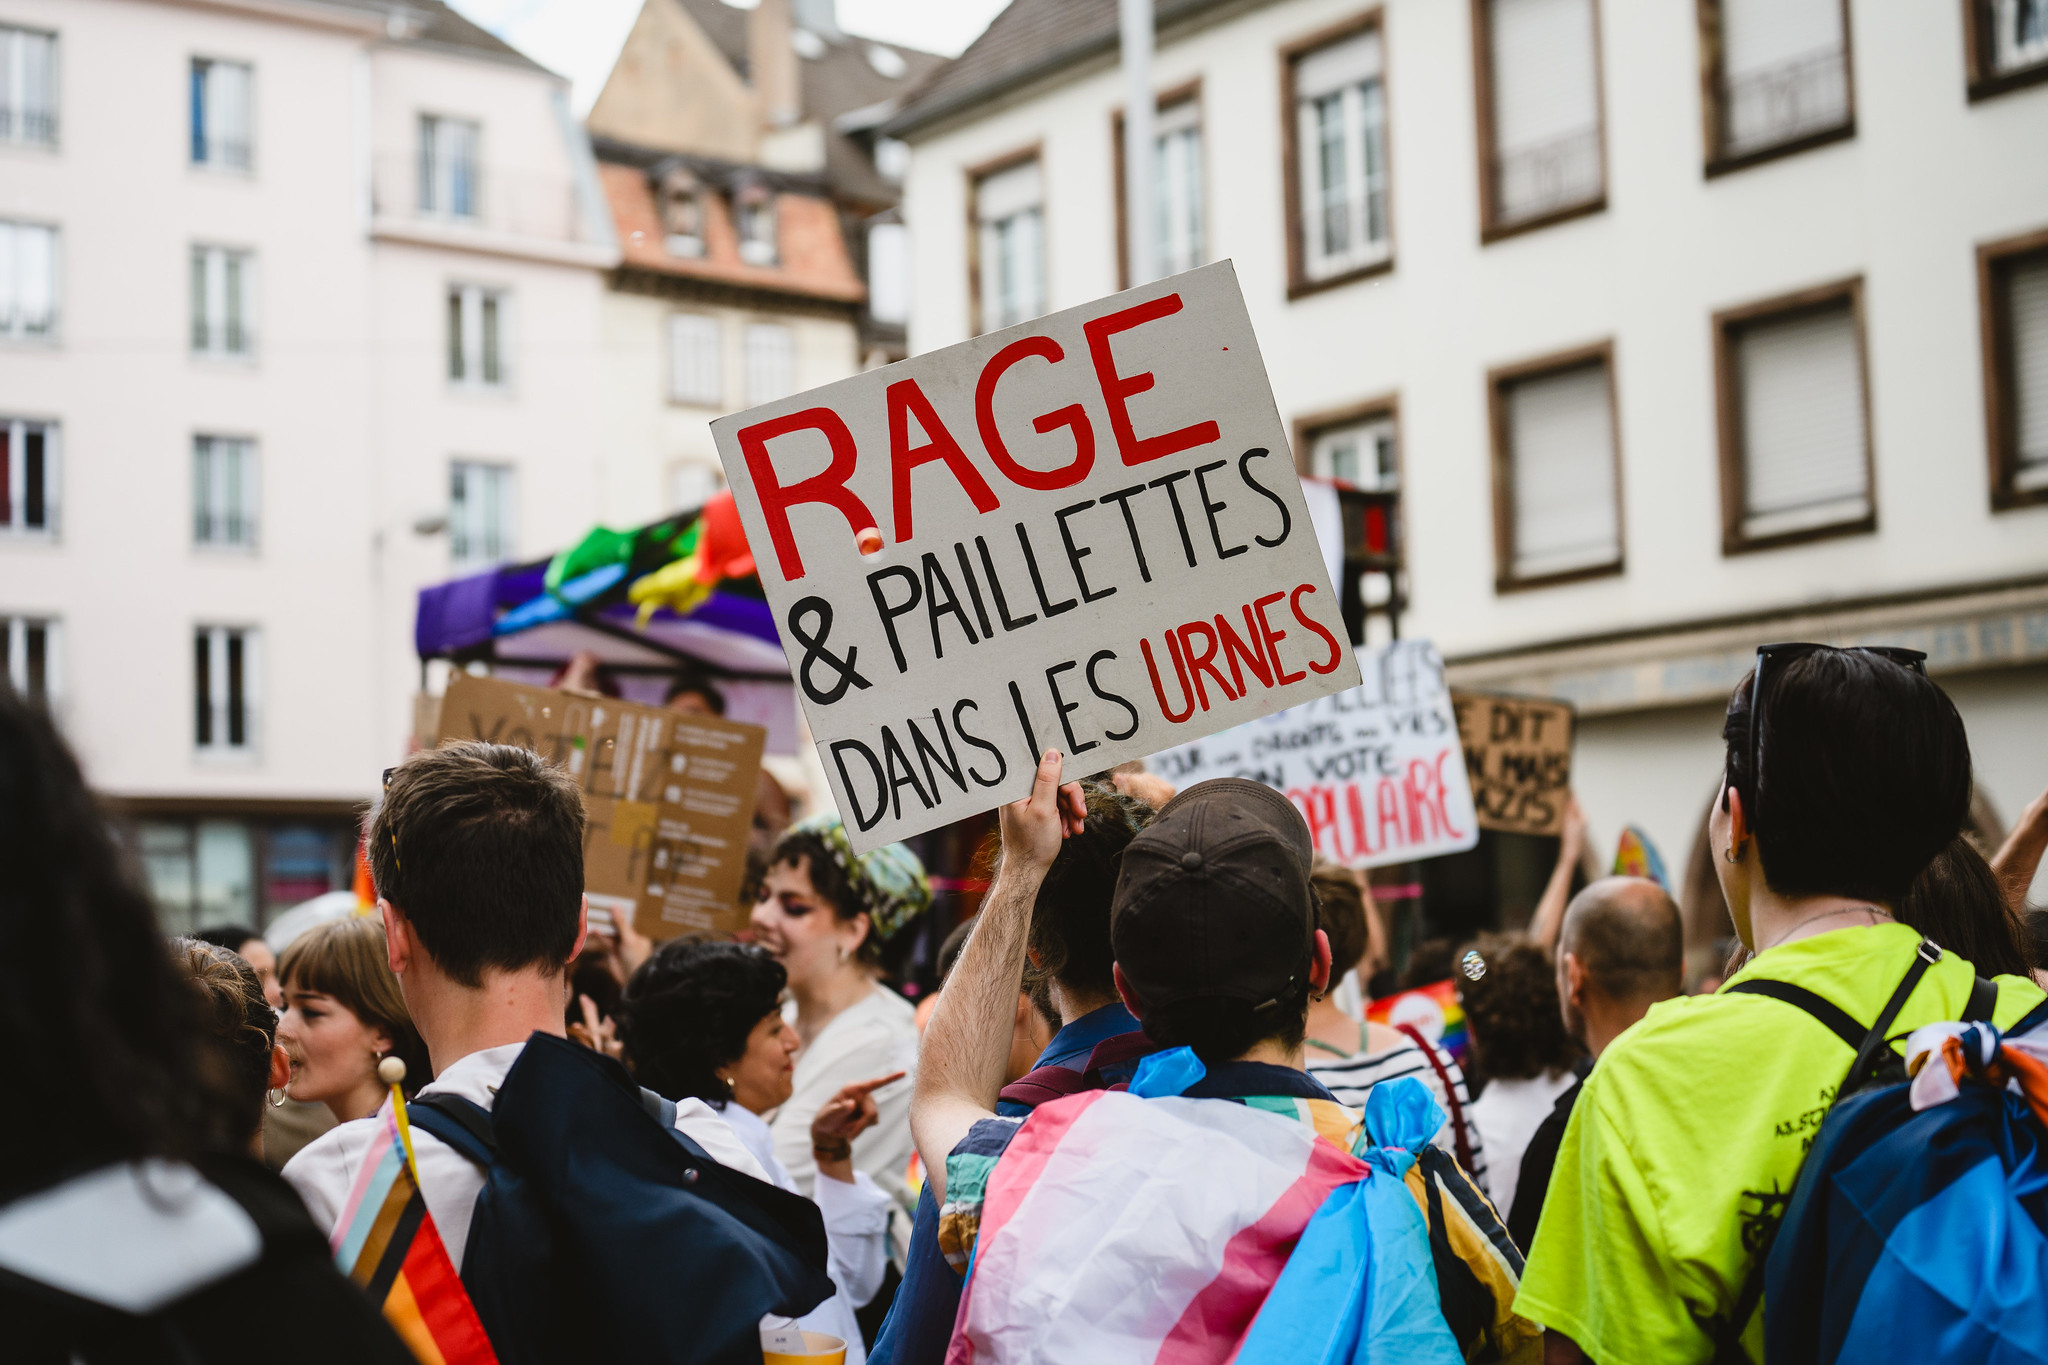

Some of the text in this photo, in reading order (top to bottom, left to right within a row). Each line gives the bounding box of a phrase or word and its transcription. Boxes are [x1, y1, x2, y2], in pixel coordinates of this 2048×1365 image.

[737, 293, 1221, 581] RAGE
[787, 447, 1292, 705] & PAILLETTES
[829, 583, 1341, 832] DANS LES URNES
[1305, 743, 1399, 781] VOTE
